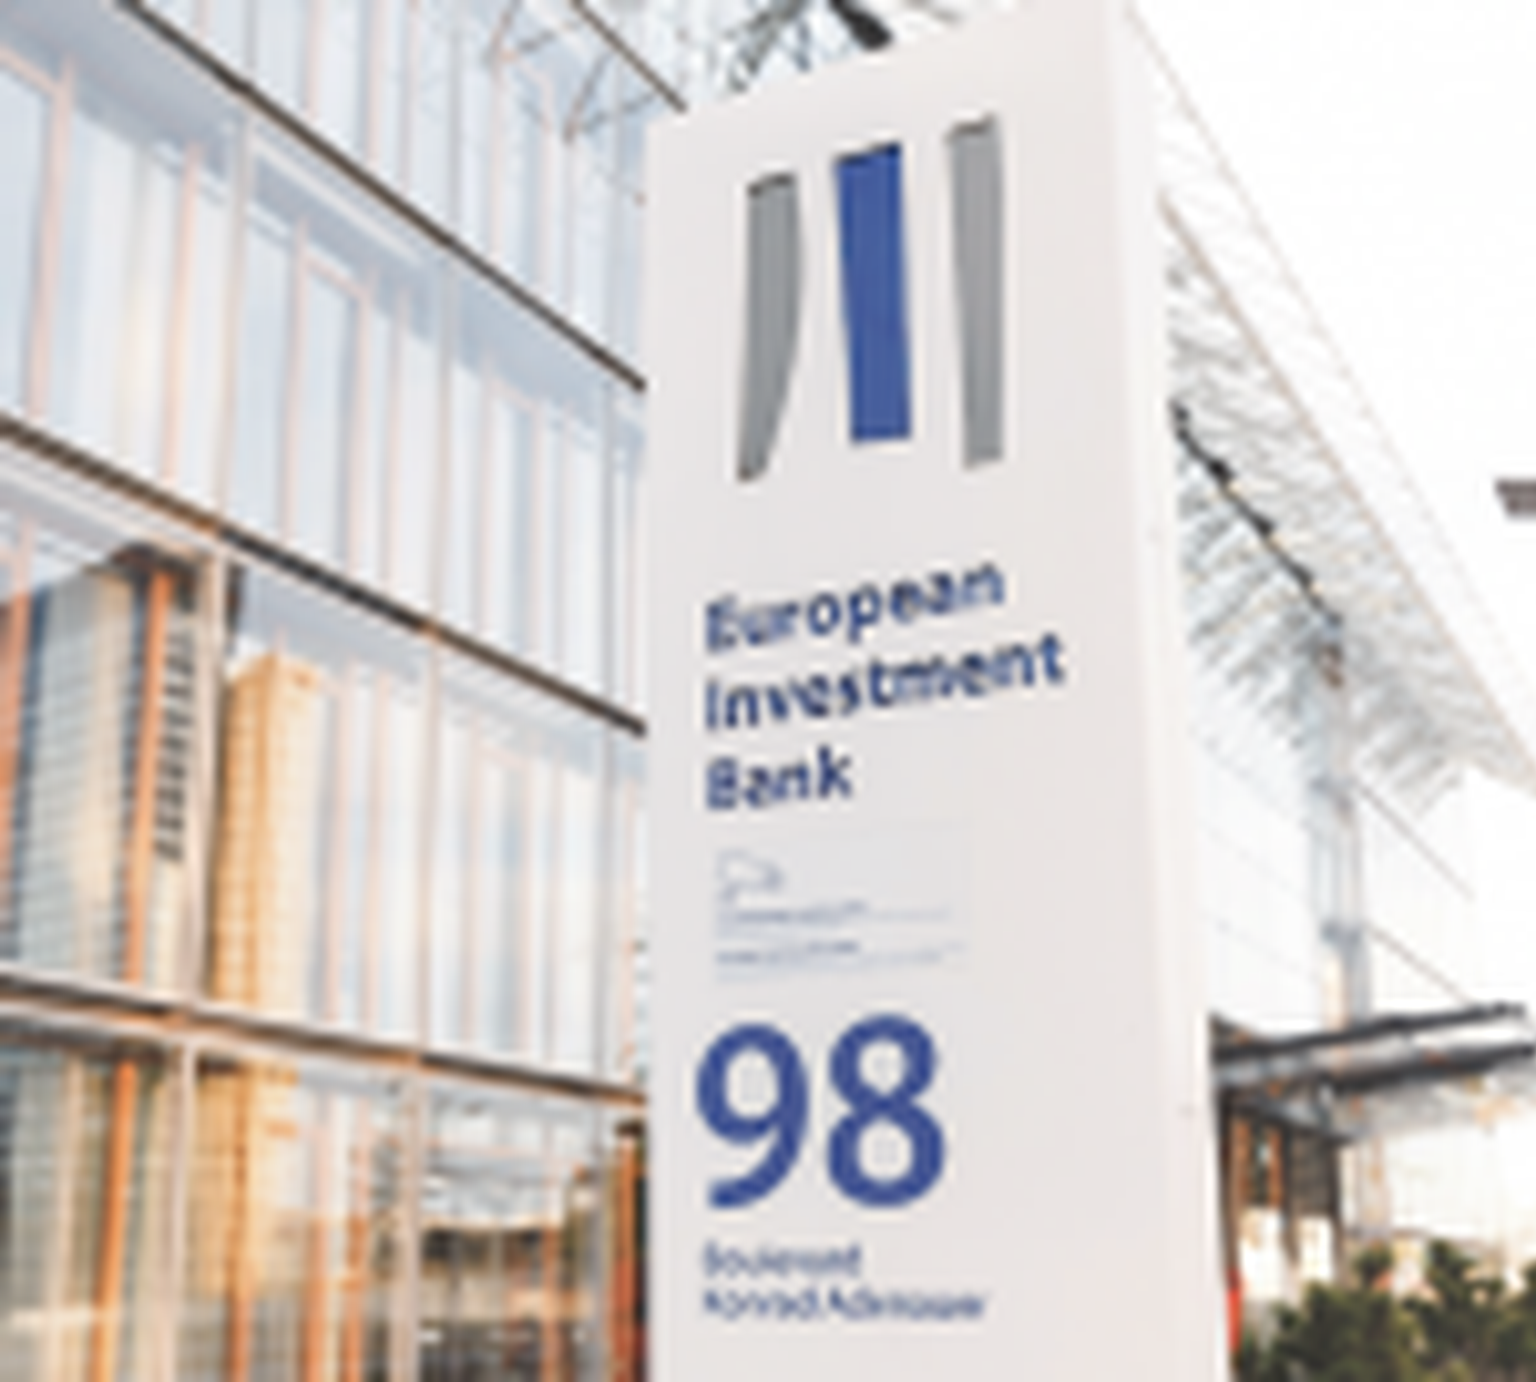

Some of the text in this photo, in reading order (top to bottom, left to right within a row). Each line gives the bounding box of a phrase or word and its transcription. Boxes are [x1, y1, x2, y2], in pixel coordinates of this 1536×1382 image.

[704, 562, 1005, 650] European
[704, 631, 1064, 731] Investment
[704, 743, 854, 811] Bank
[693, 1011, 947, 1210] 98
